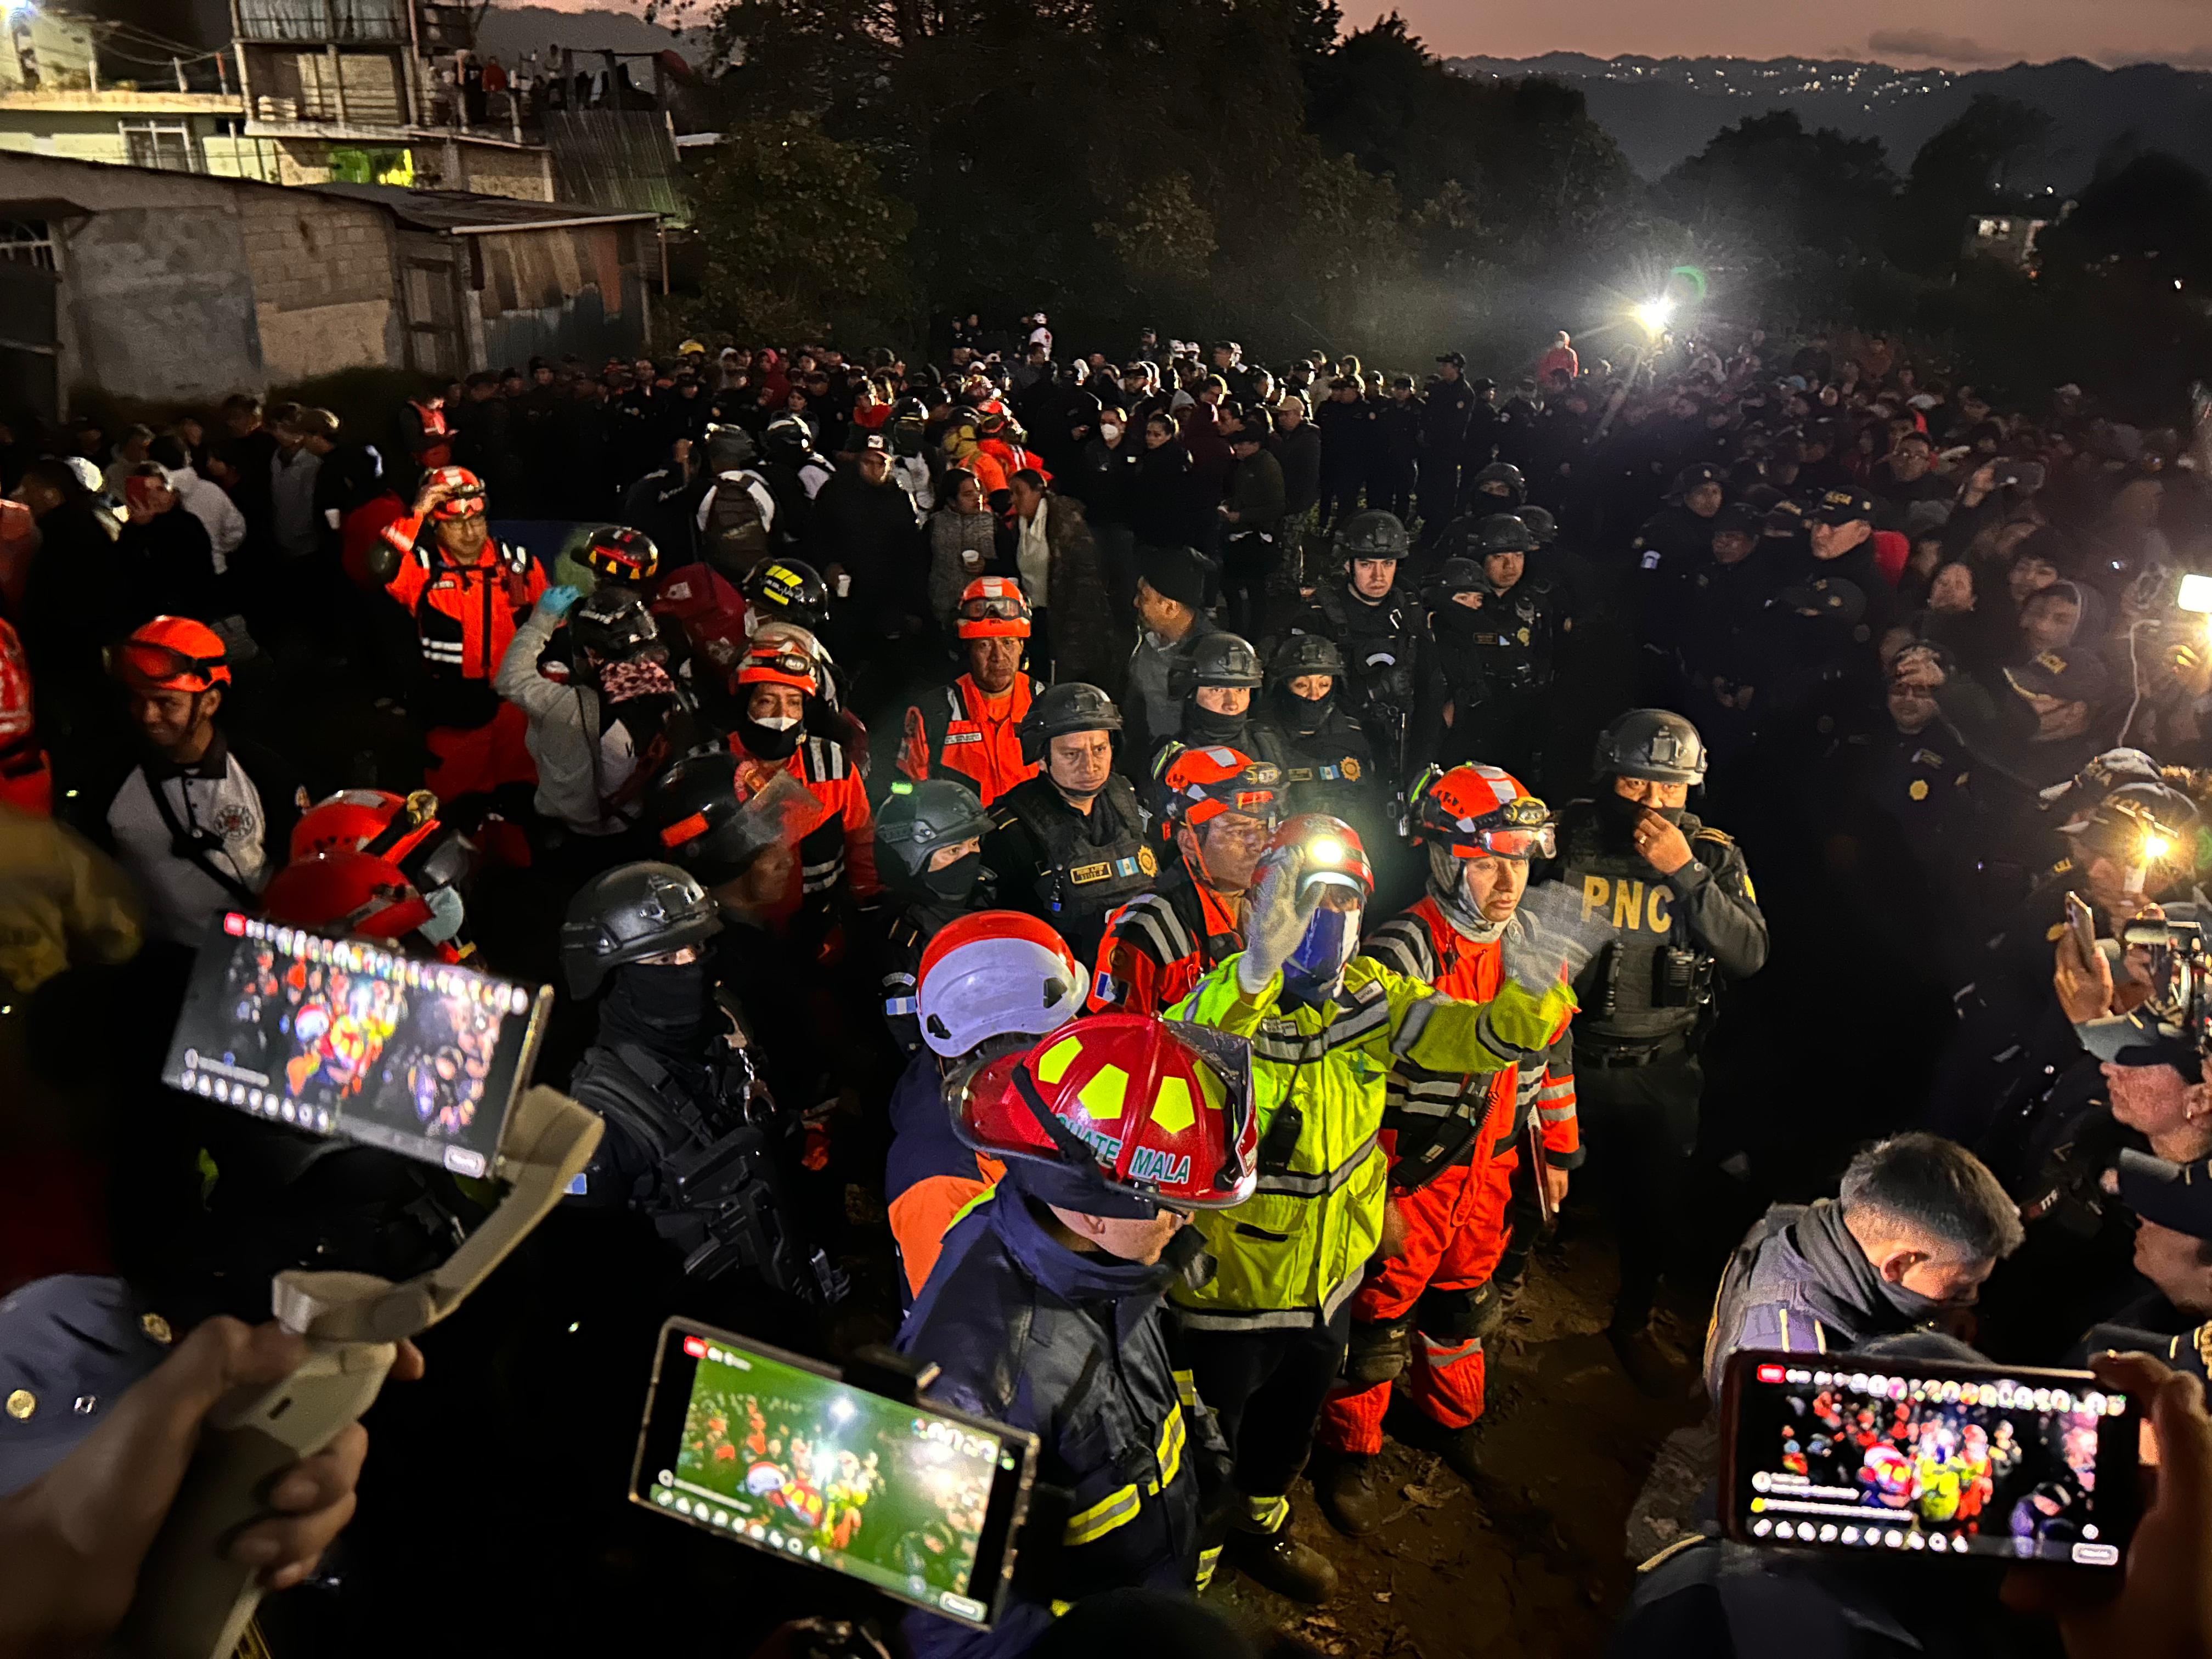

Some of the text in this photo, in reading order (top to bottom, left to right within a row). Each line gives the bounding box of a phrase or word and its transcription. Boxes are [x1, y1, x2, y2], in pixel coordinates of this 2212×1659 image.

[1581, 876, 1675, 933] PNC
[1058, 1116, 1190, 1183] ATE MALA
